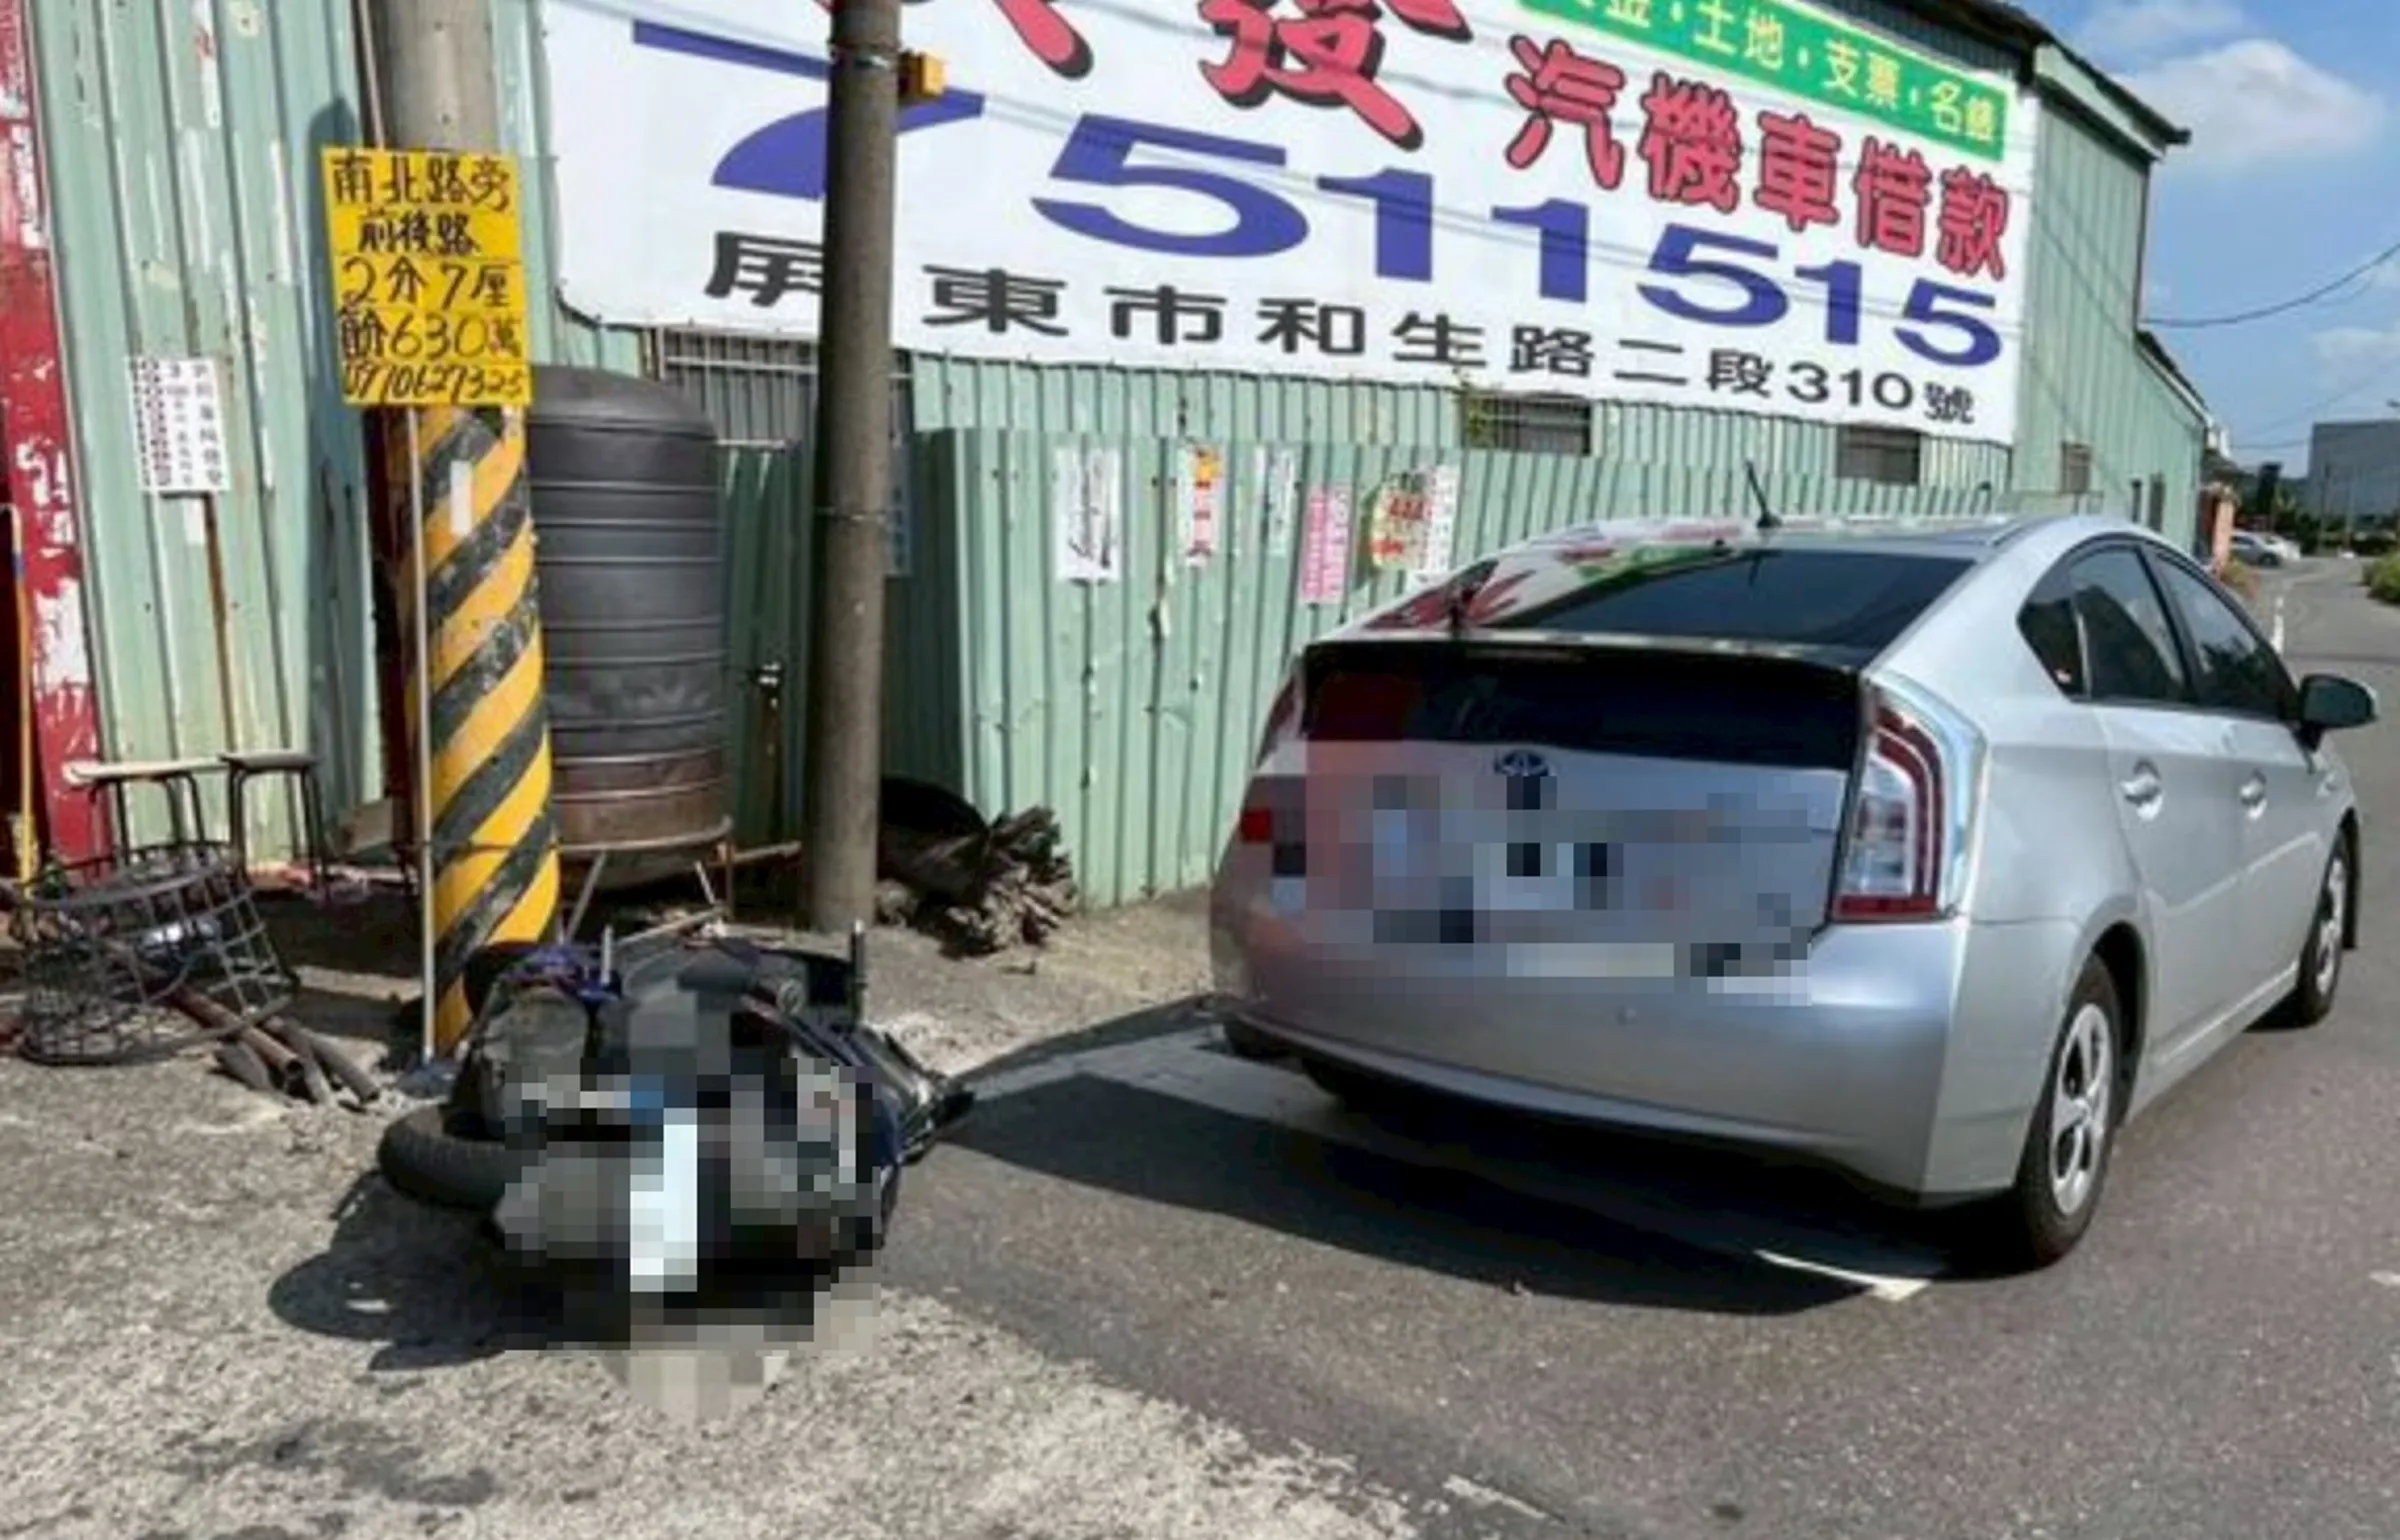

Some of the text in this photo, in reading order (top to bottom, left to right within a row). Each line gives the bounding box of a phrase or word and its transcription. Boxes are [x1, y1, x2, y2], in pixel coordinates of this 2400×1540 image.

[331, 153, 511, 212] 南北路旁
[632, 18, 2004, 368] 7511515
[1505, 35, 2010, 282] 汽機車借款
[704, 231, 1976, 425] 屏東市和生路二段310號
